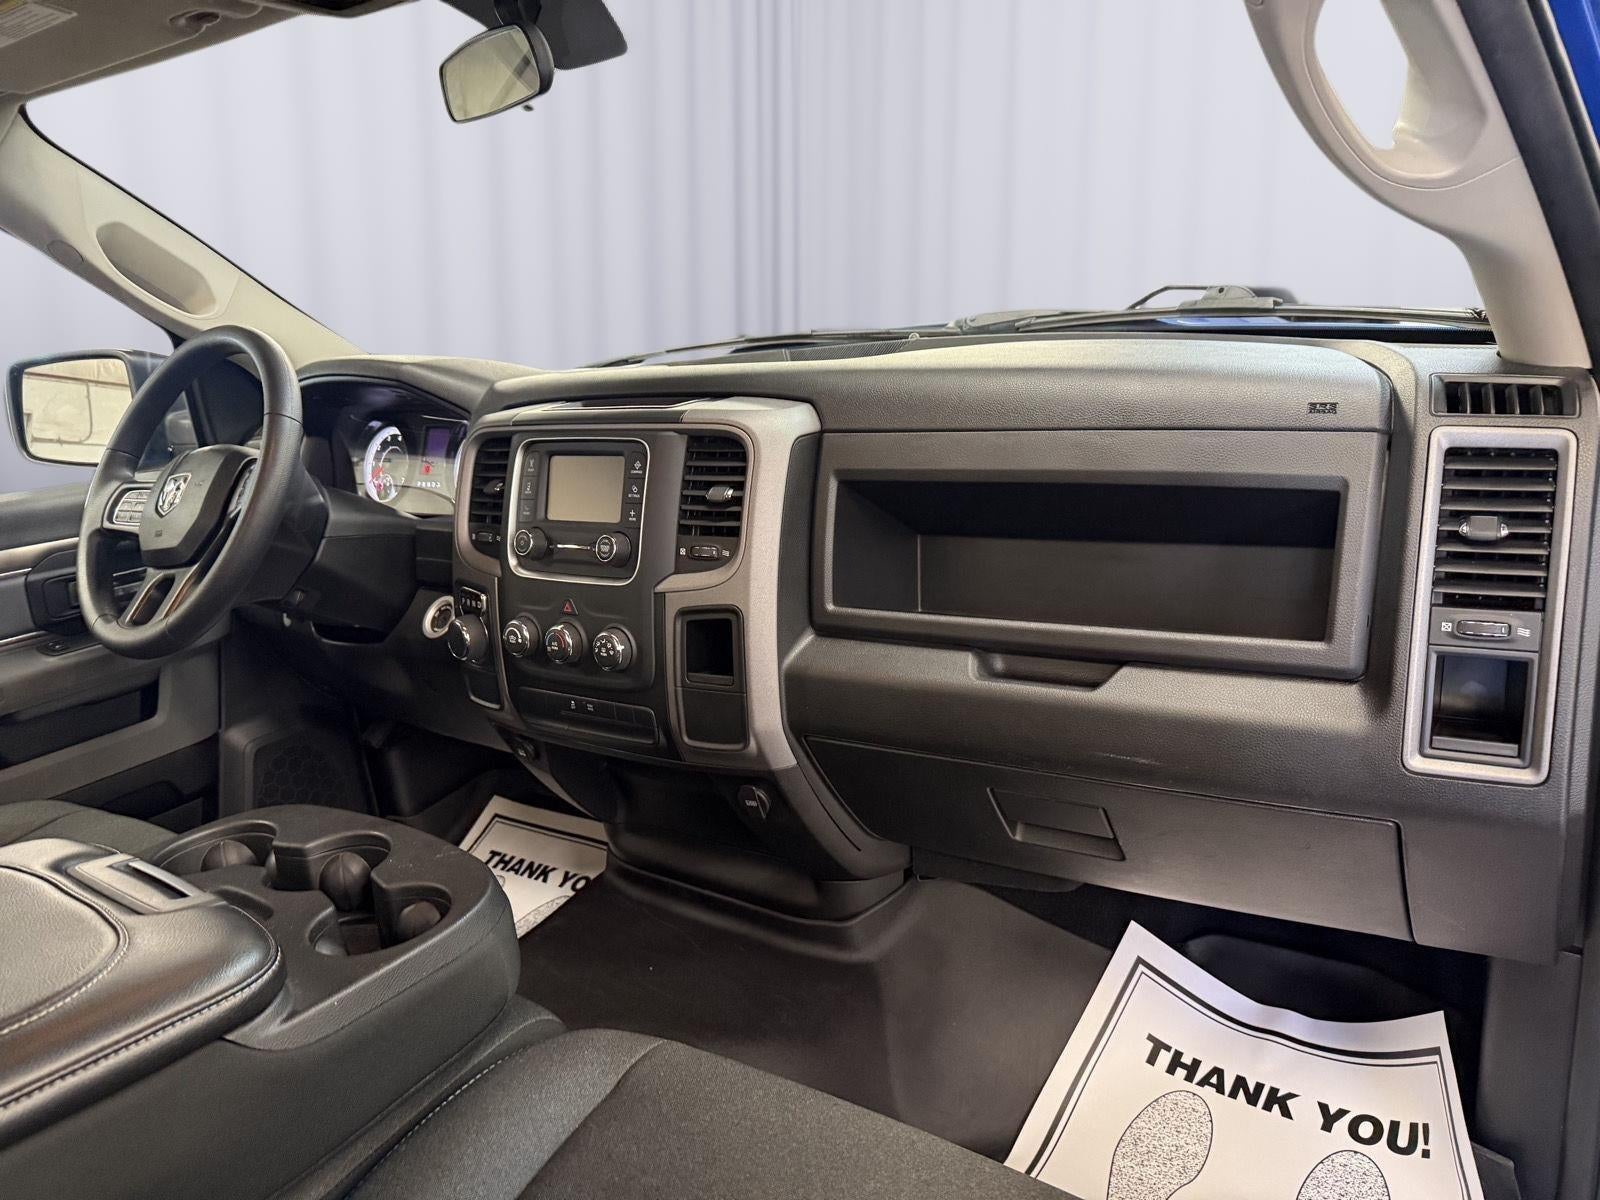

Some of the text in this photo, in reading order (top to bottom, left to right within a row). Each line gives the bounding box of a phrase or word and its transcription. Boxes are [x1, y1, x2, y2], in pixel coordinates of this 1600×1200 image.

[484, 850, 557, 883] THANK
[1145, 1032, 1431, 1158] THANK YOU!
